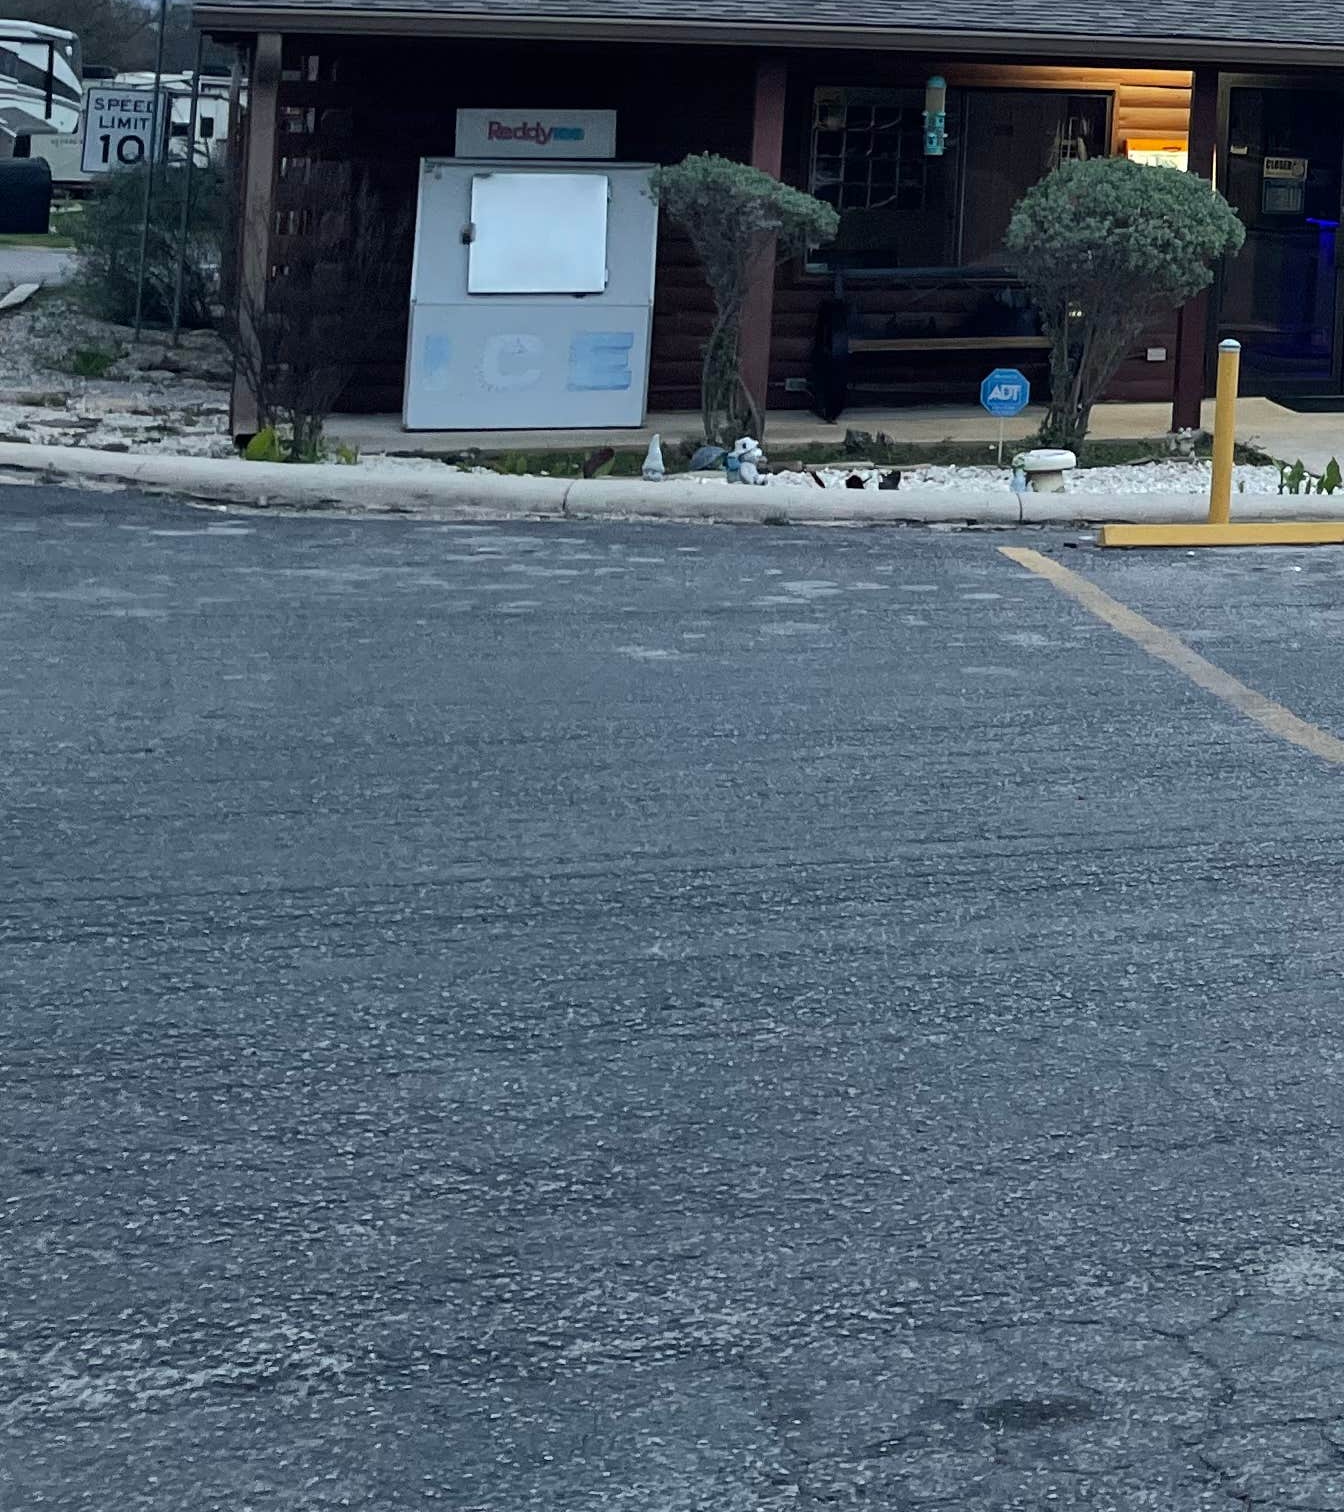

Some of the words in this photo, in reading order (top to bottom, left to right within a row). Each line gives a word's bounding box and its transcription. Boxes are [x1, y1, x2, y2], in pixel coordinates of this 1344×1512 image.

[99, 115, 151, 131] LIMIT
[99, 134, 145, 165] 10
[423, 332, 635, 392] ICE
[987, 383, 1022, 401] ADT
